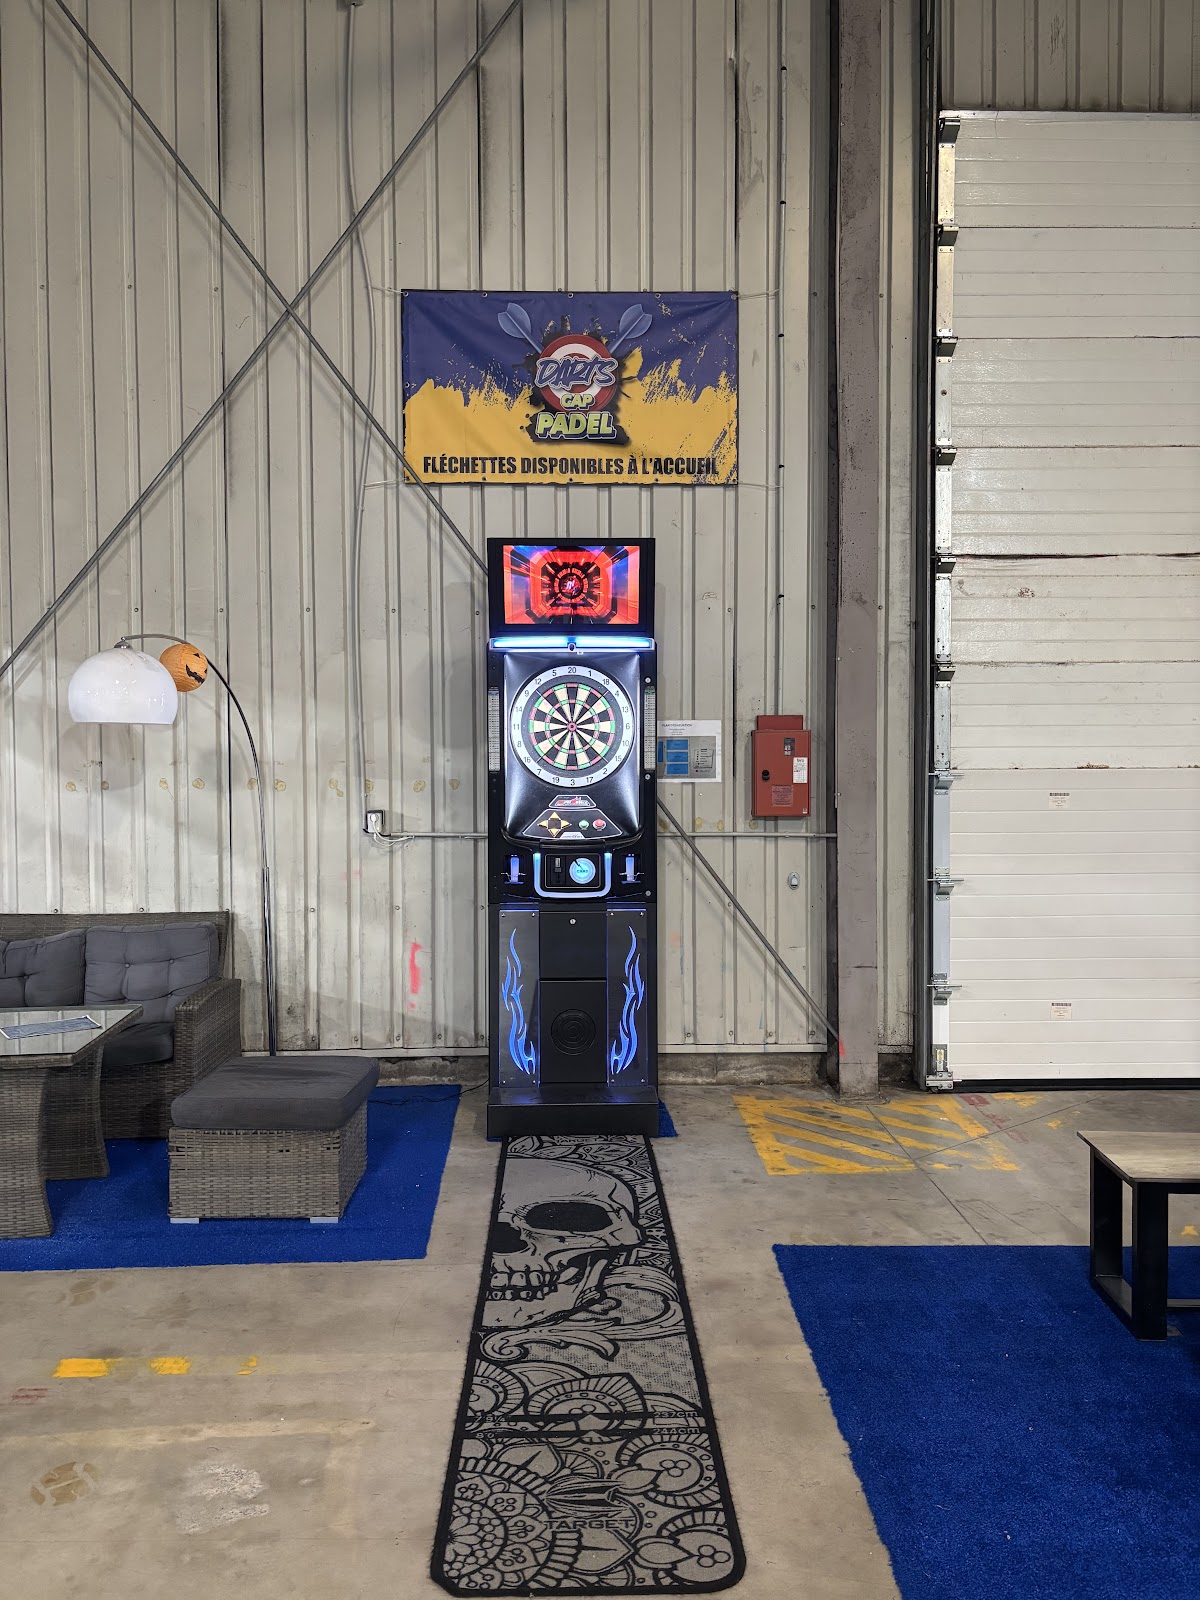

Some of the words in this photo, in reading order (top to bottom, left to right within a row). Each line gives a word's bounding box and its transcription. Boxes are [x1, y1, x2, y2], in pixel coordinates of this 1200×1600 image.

[535, 355, 618, 390] DARTS
[560, 393, 595, 410] CAP
[536, 412, 616, 439] PADEL
[423, 453, 516, 474] FLÉCHETTES
[520, 457, 623, 475] DISPONIBLES
[627, 454, 639, 475] À
[544, 1520, 636, 1530] TARGET
